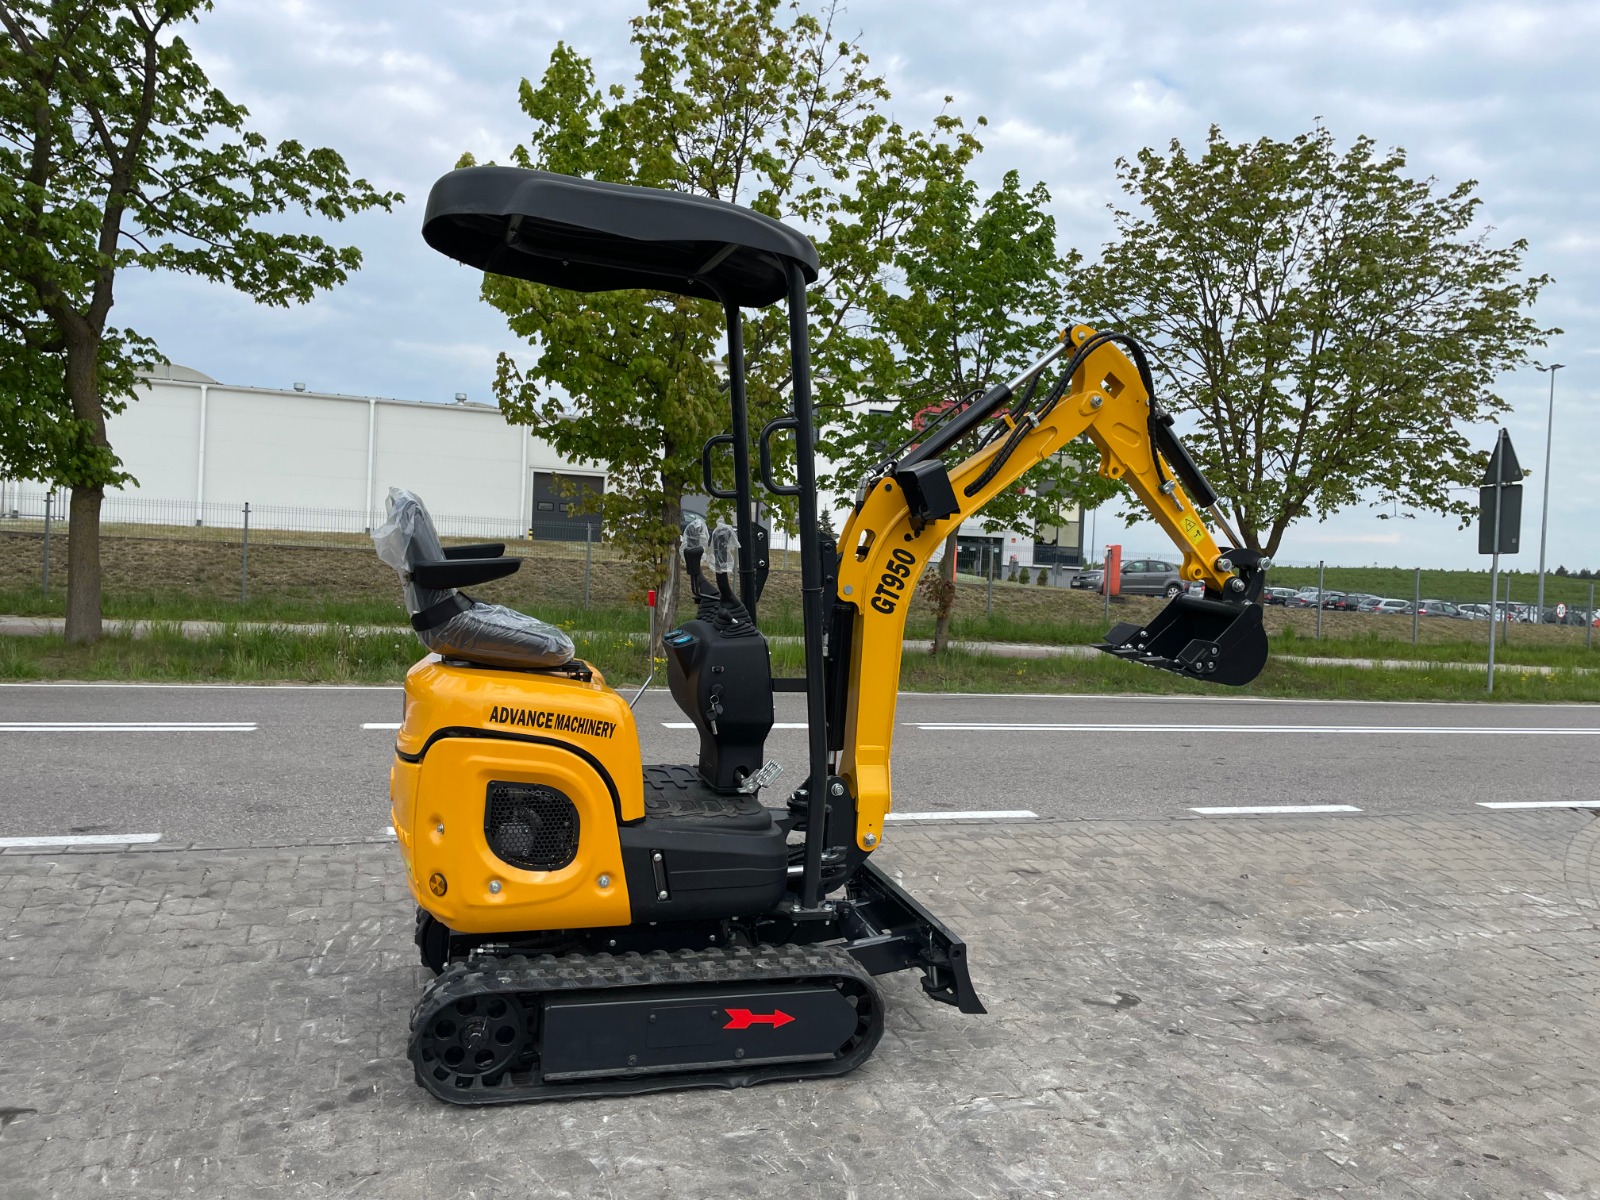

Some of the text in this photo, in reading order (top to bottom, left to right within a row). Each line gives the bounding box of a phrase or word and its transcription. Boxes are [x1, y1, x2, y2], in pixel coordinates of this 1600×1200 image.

[871, 548, 916, 614] GT950
[489, 706, 617, 739] ADVANCE MACHINERY
